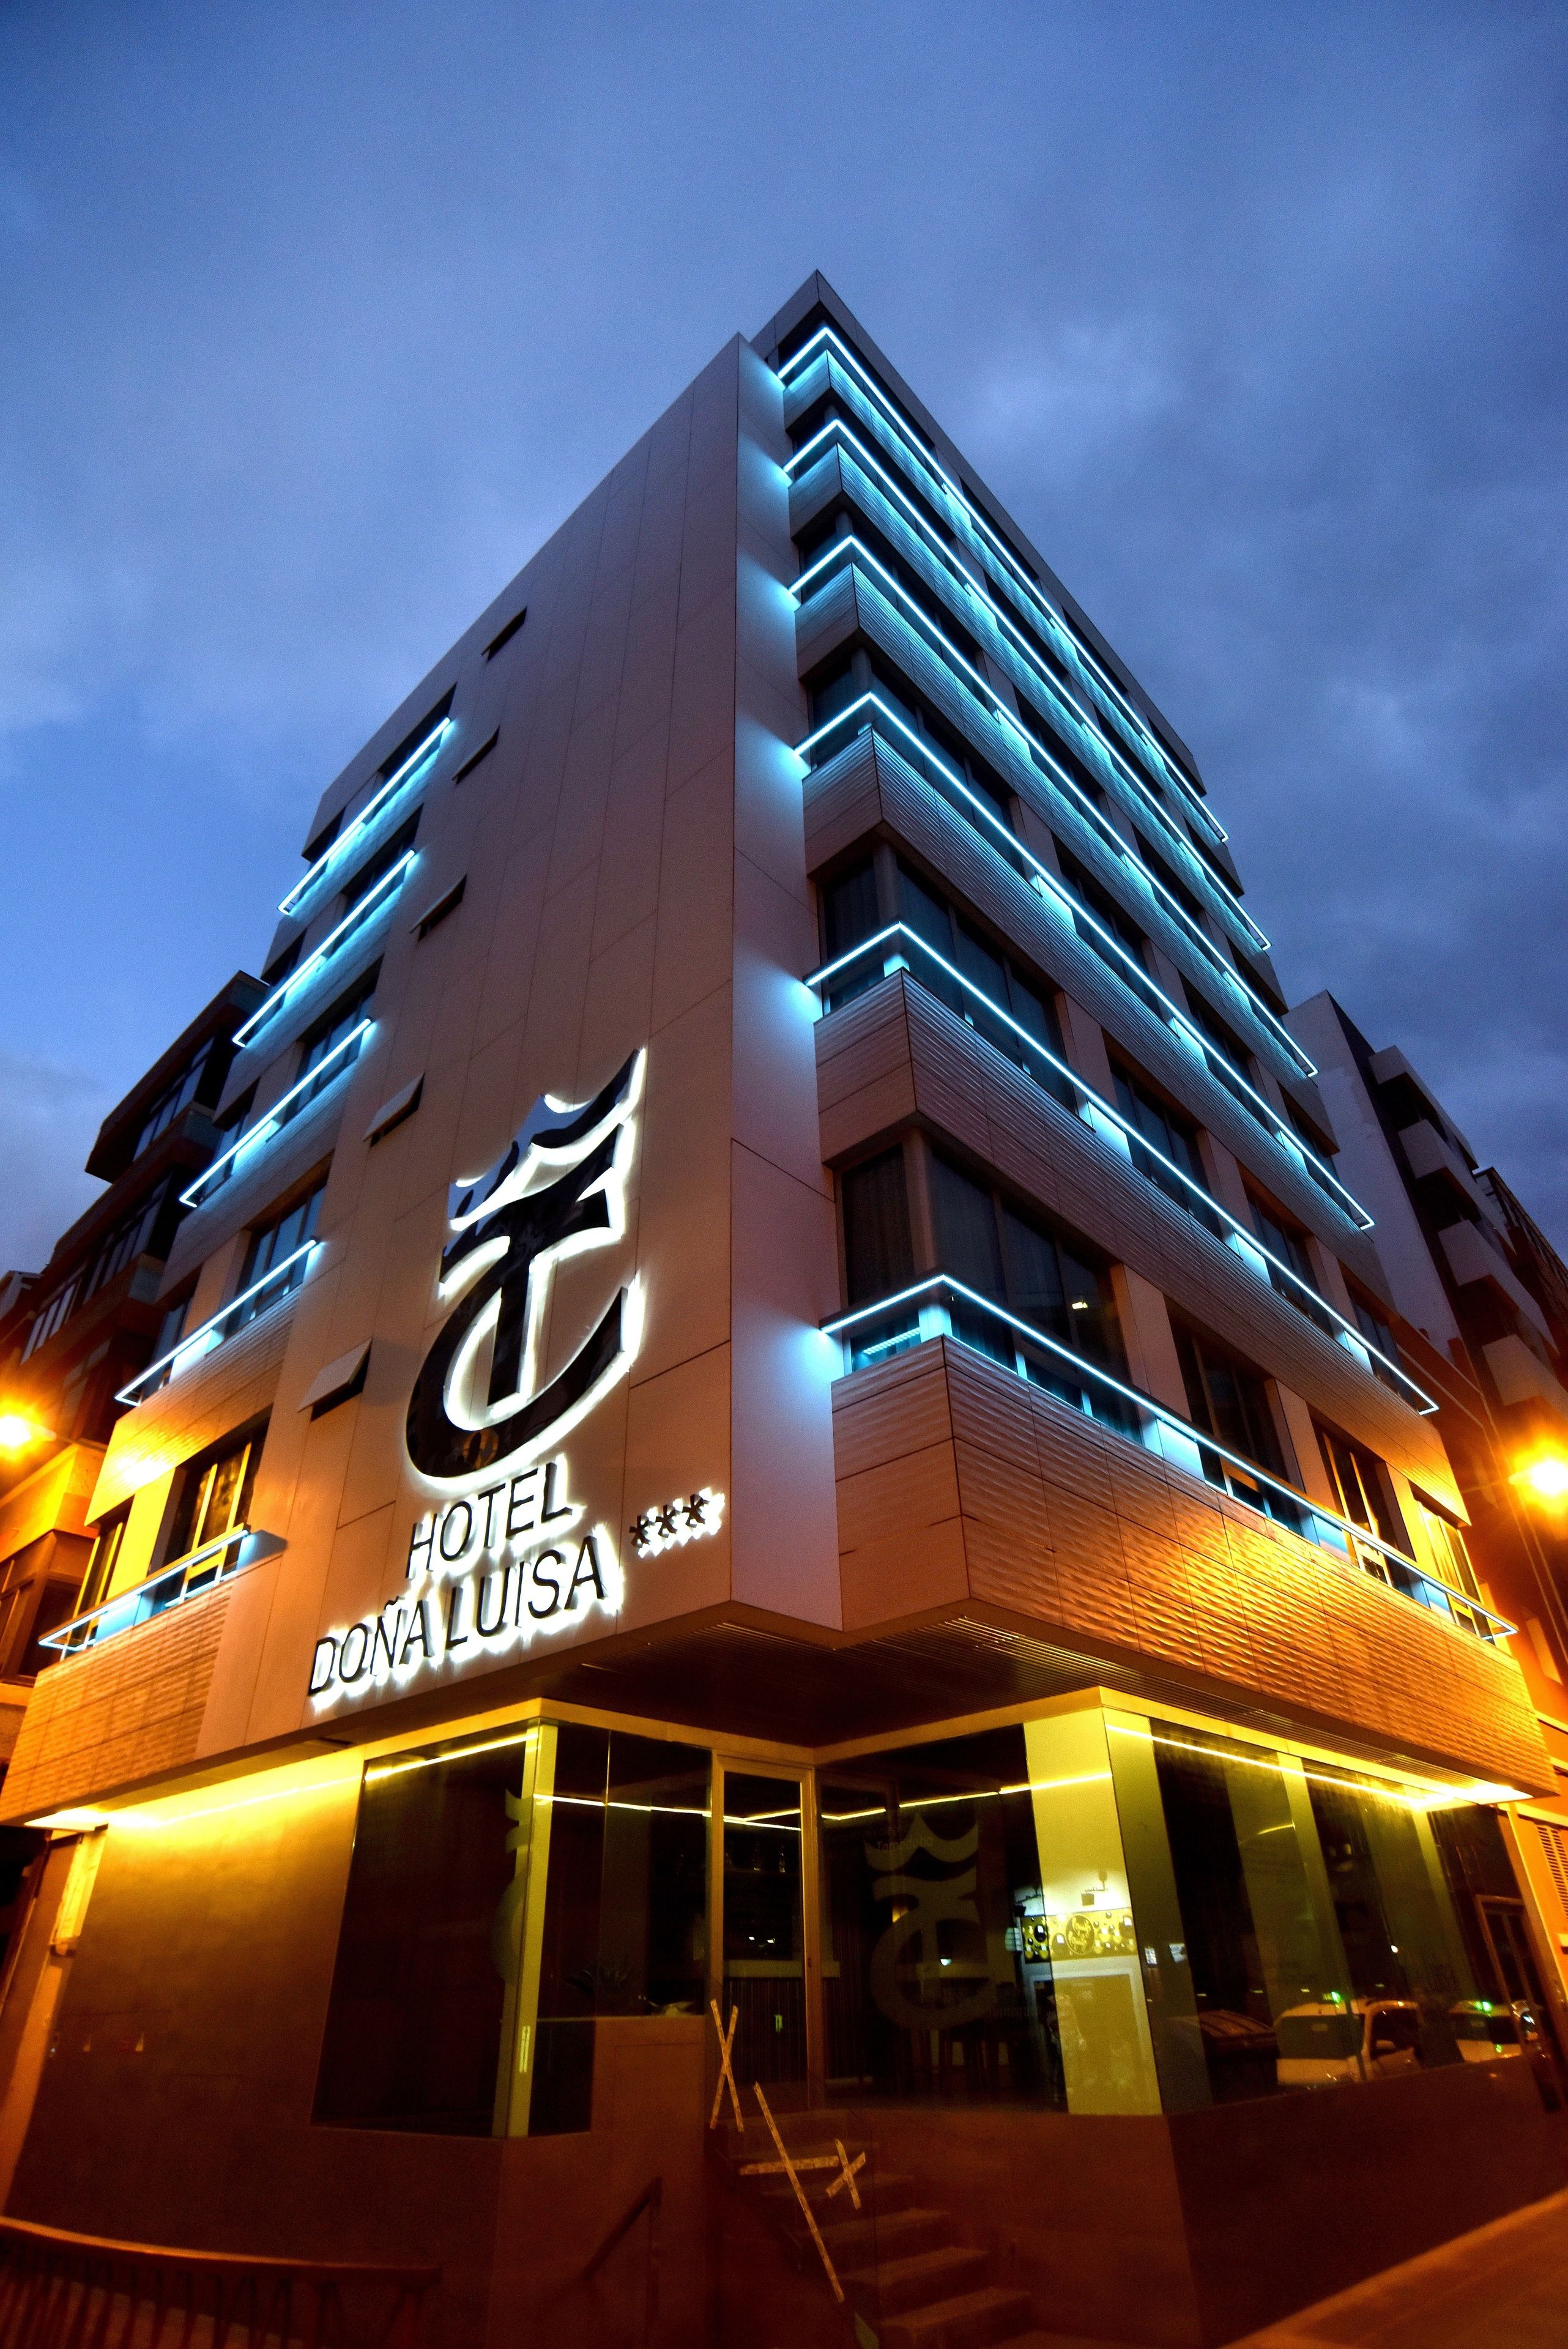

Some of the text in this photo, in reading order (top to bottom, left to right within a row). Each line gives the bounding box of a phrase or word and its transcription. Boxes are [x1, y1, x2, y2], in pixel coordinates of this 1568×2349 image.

[405, 1461, 572, 1579] HOTEL
[307, 1535, 605, 1696] DOÑA LUISA
